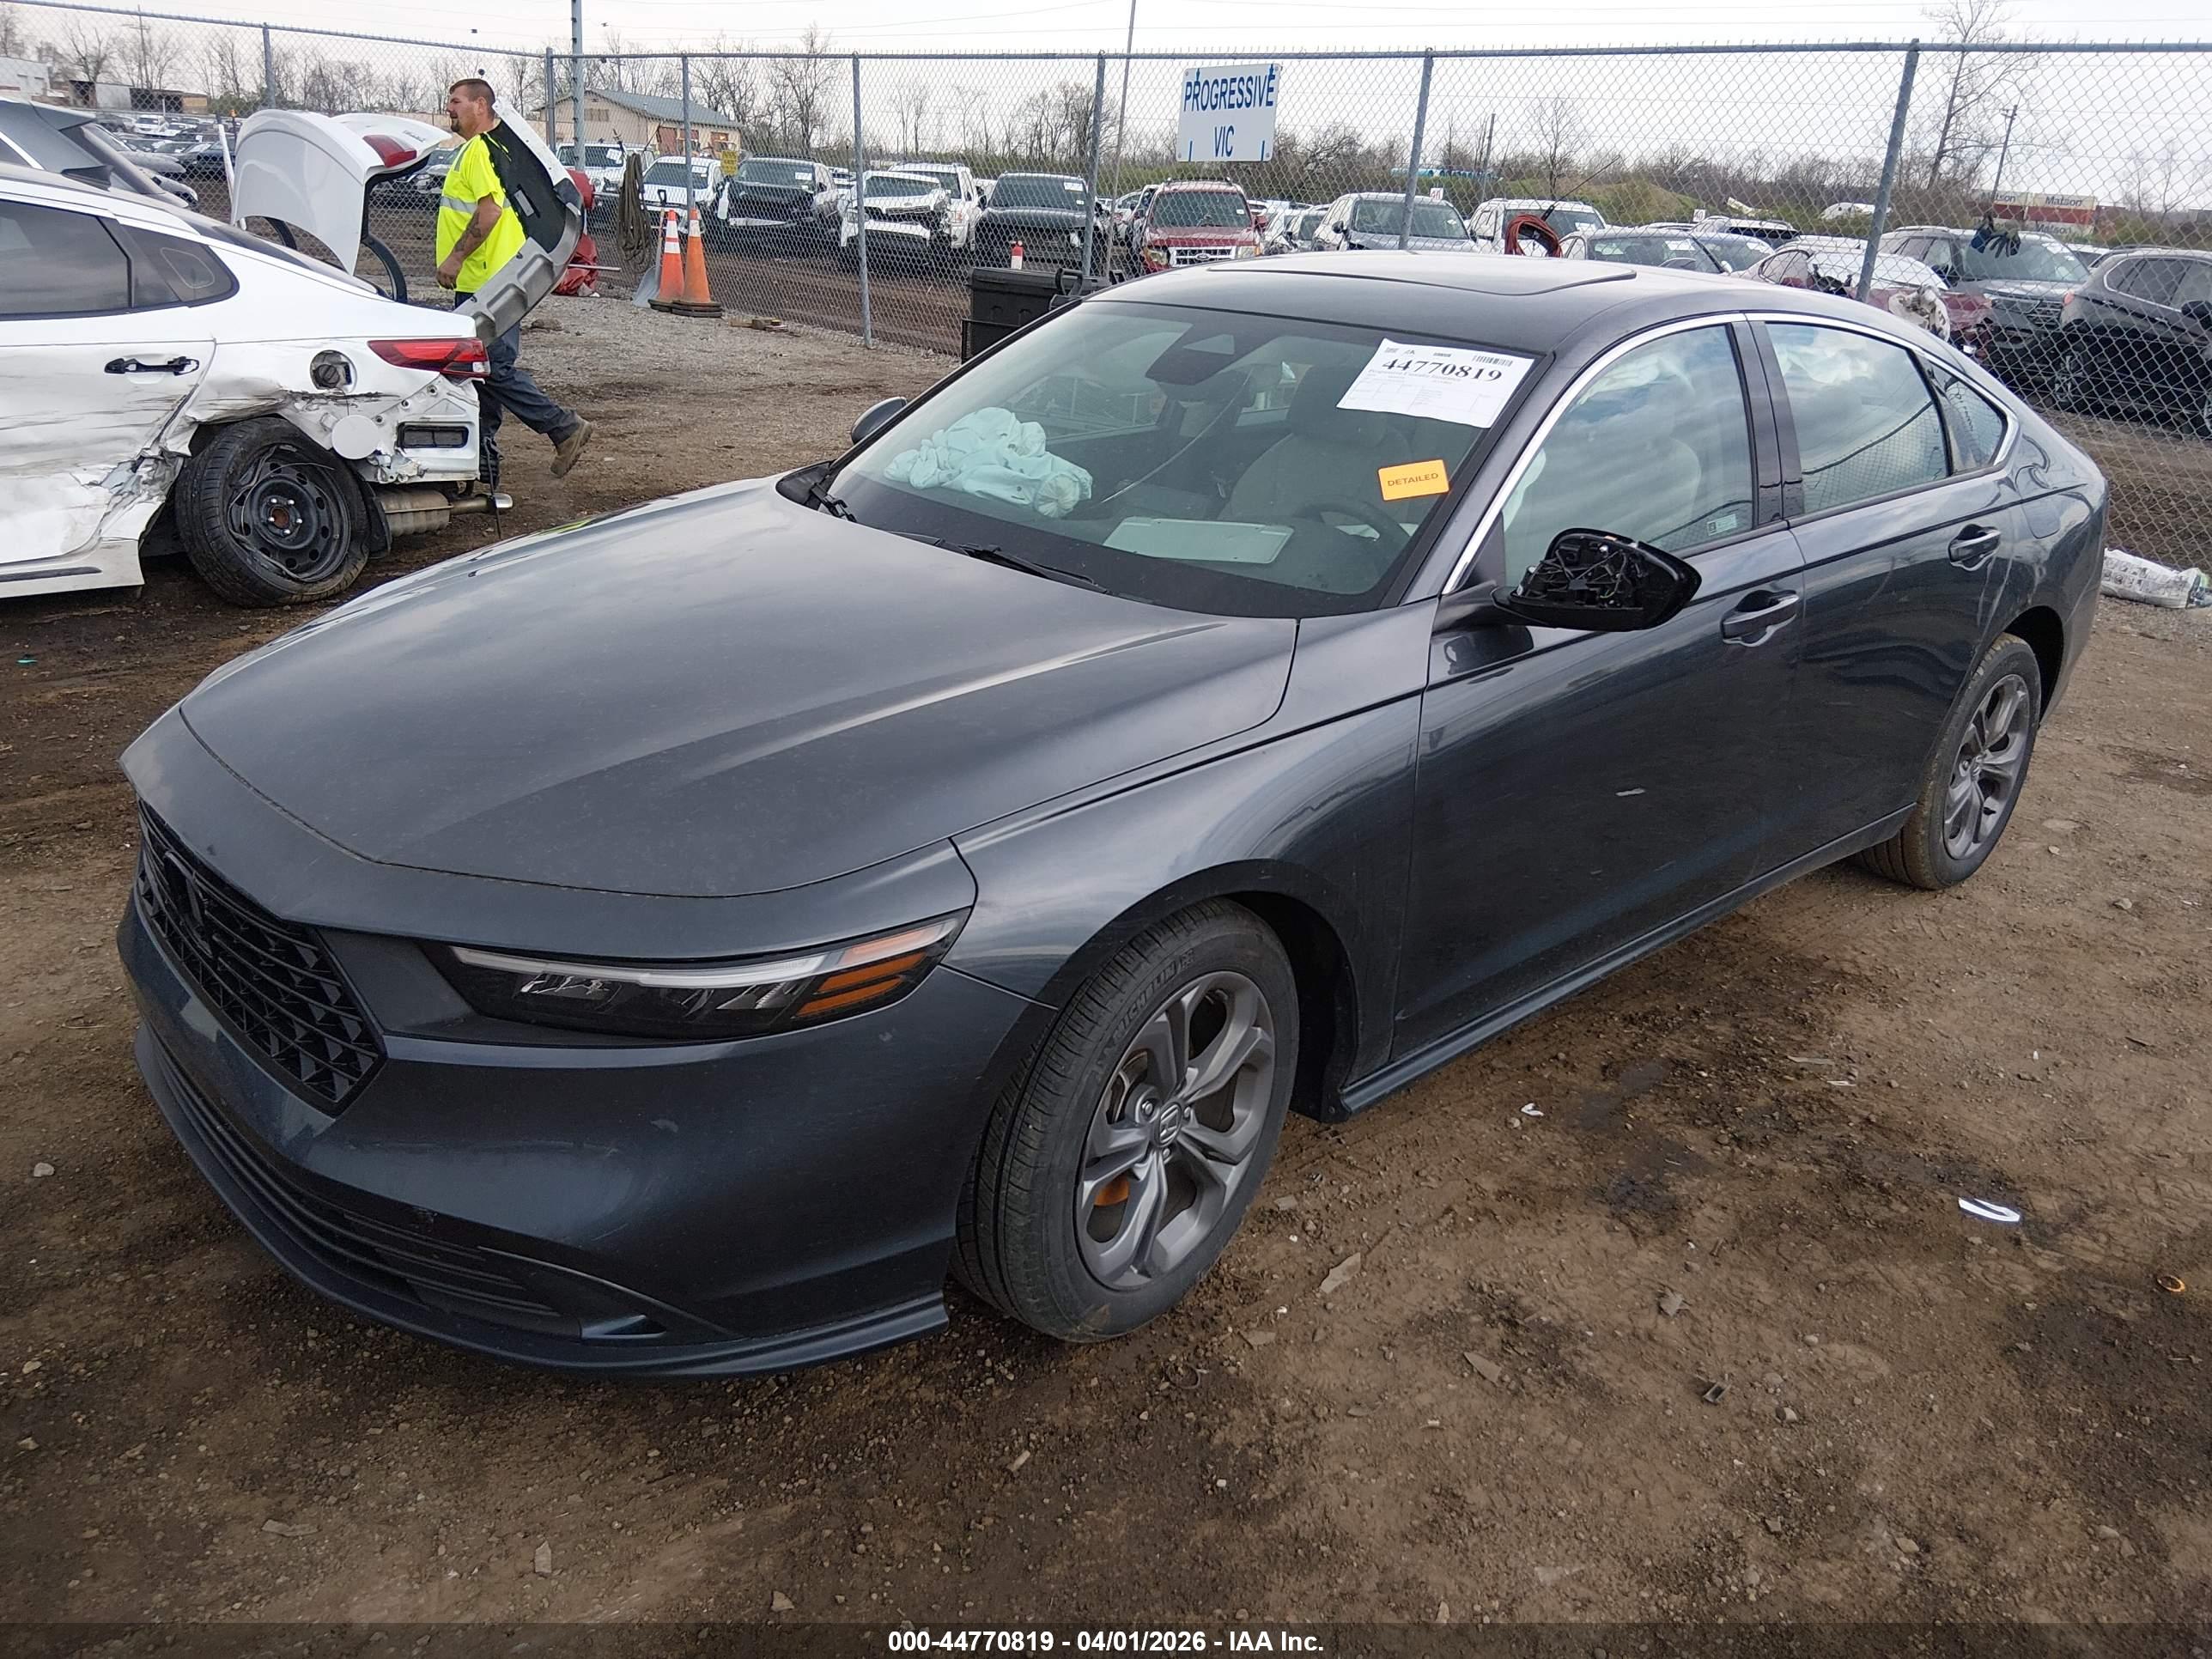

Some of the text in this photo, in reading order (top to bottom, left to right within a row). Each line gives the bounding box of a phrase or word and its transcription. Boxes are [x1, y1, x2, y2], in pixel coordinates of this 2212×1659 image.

[1183, 75, 1276, 112] PROGRESSIVE
[1214, 125, 1235, 157] VIC
[2045, 196, 2083, 207] Matson
[1382, 357, 1503, 382] 44770819
[1387, 472, 1439, 487] DETAILED
